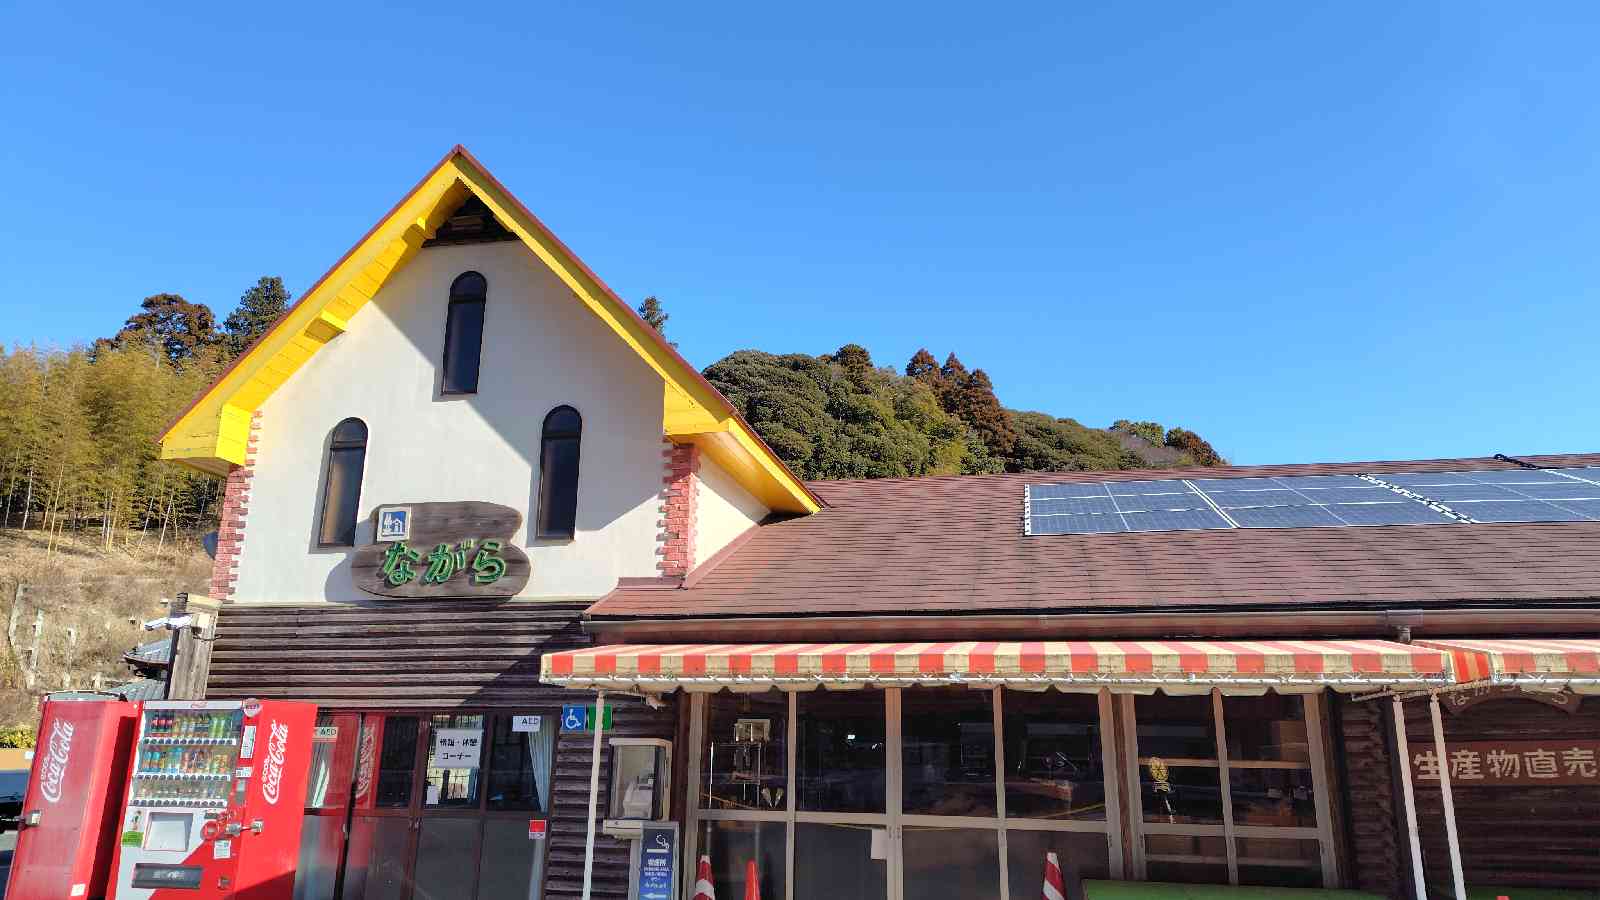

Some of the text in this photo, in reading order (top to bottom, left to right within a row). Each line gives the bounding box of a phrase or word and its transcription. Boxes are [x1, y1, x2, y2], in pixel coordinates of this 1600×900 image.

[383, 539, 506, 586] ながら
[320, 728, 337, 736] AED
[41, 718, 74, 803] Coca-Cola
[262, 719, 288, 805] Coca-Cola
[442, 752, 472, 760] コーナー
[1413, 747, 1597, 780] 生産物直売
